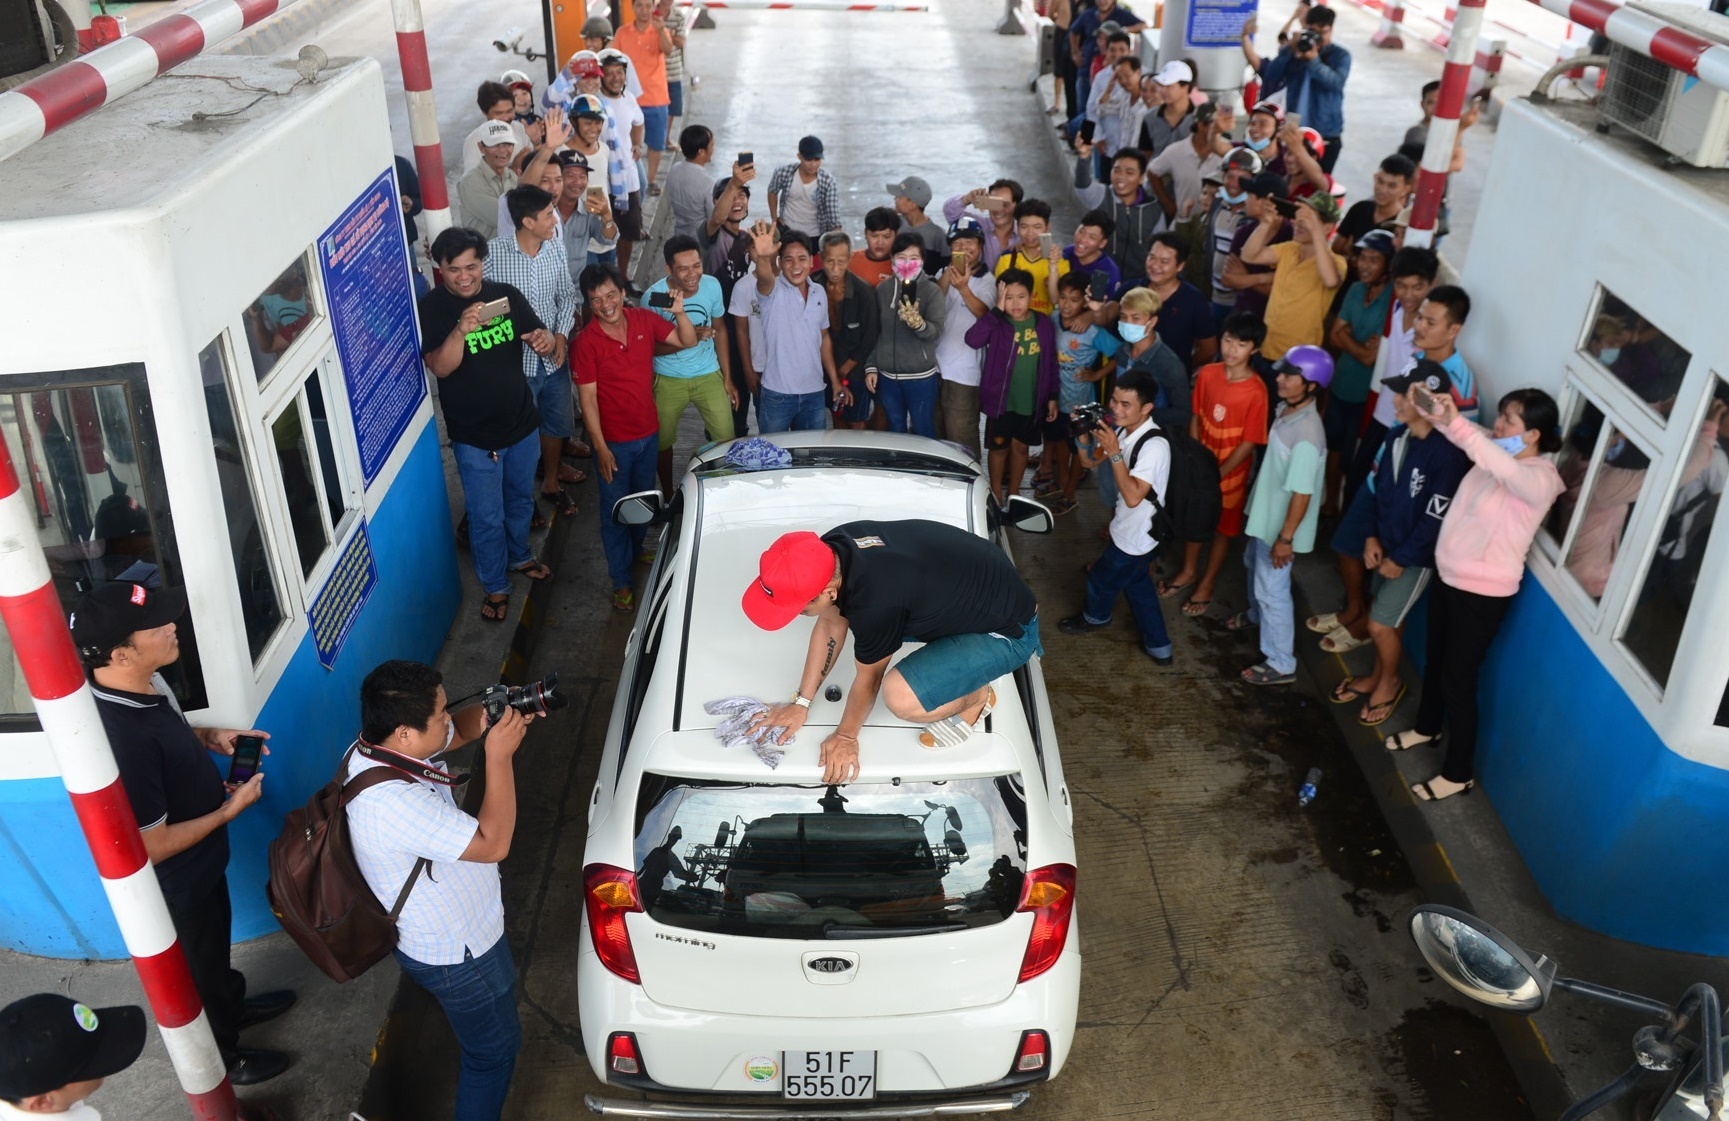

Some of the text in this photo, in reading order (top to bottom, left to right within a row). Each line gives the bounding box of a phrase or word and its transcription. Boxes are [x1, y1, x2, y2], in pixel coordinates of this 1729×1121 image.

[465, 319, 514, 354] FURY
[423, 769, 450, 783] Canon
[815, 960, 846, 971] KIA
[806, 1051, 854, 1073] 51F
[787, 1075, 872, 1096] 555.07
